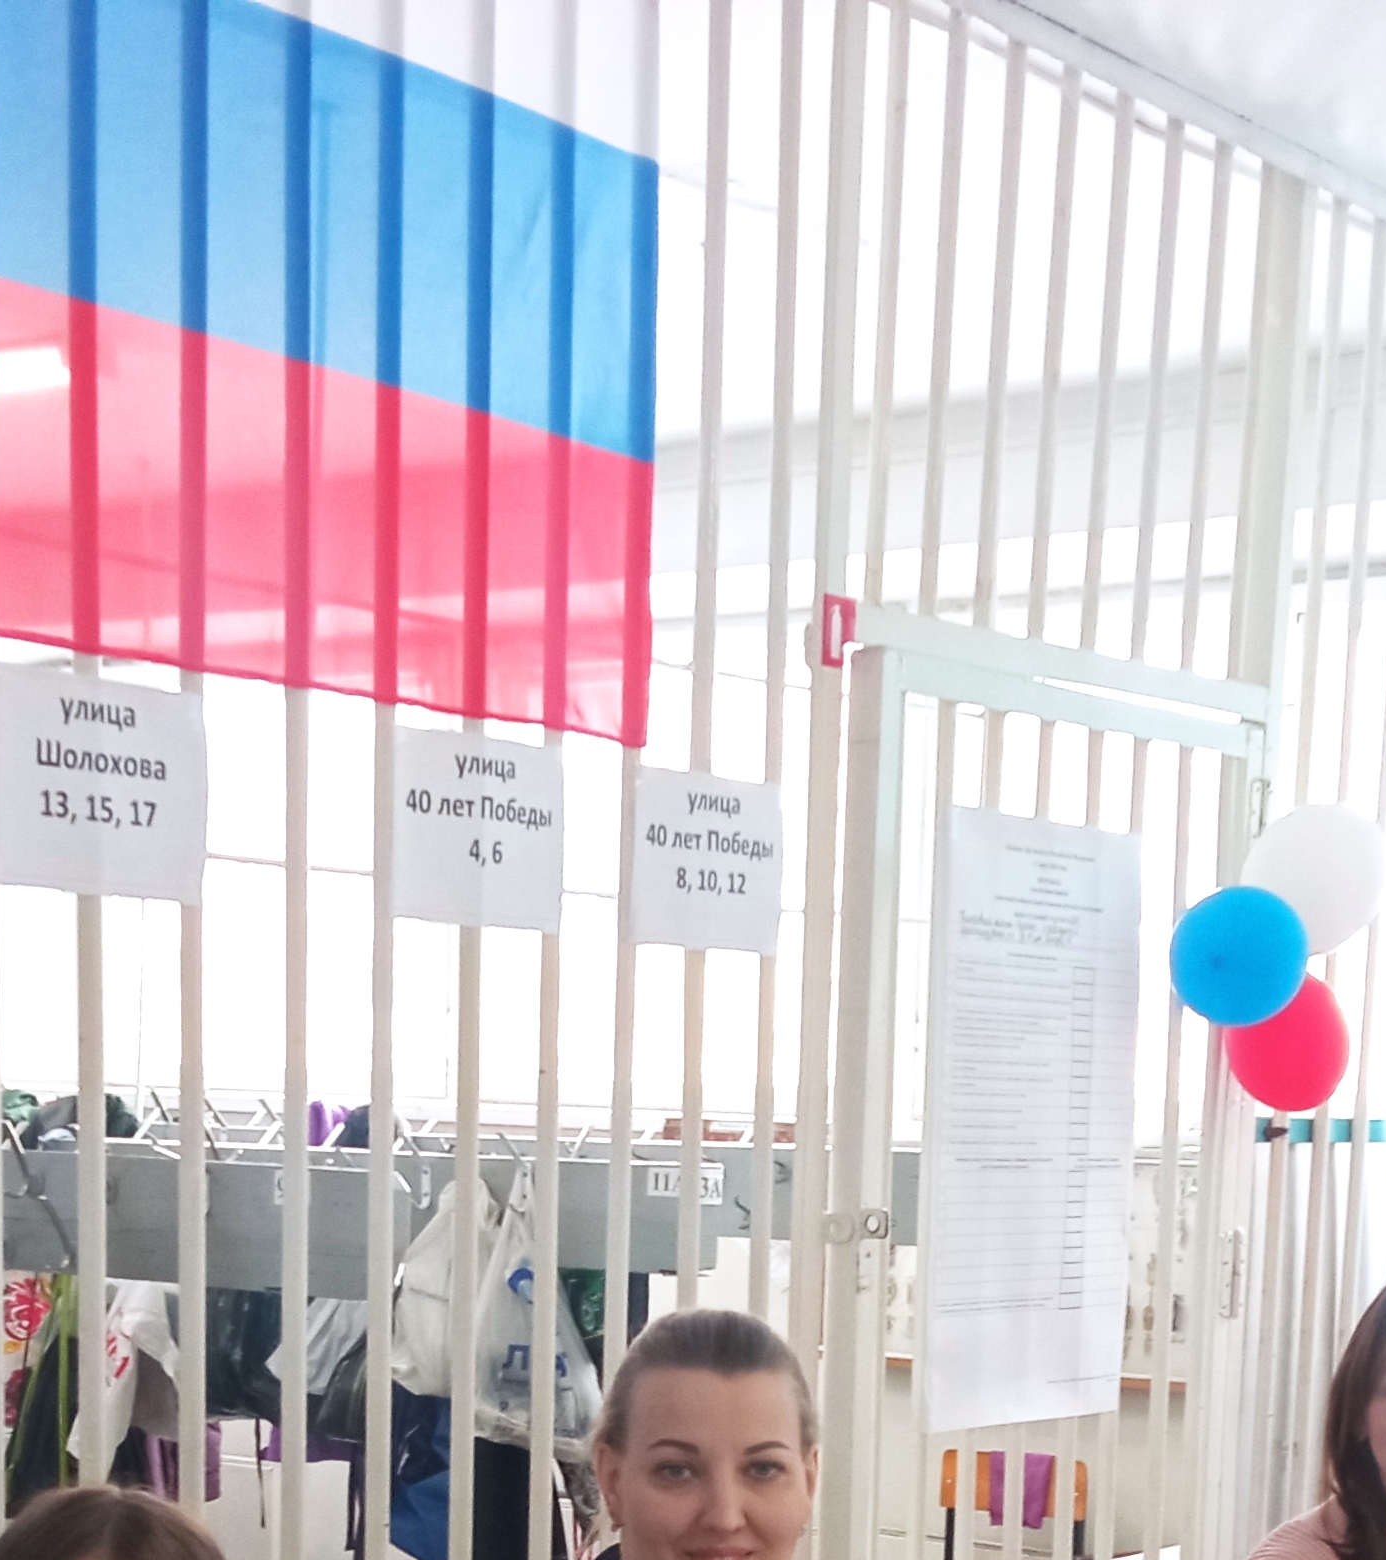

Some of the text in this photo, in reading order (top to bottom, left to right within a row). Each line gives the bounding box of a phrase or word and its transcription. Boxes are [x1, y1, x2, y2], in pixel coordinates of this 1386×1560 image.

[60, 697, 136, 732] улица
[36, 737, 167, 781] Шолохова
[455, 753, 516, 781] улица
[40, 789, 157, 829] 13, 15, 17
[406, 788, 552, 830] 40 лет Победы
[687, 791, 741, 818] улица
[469, 839, 503, 867] 4, 6
[645, 824, 774, 860] 40 лет Победы
[676, 868, 746, 896] 8, 10, 12
